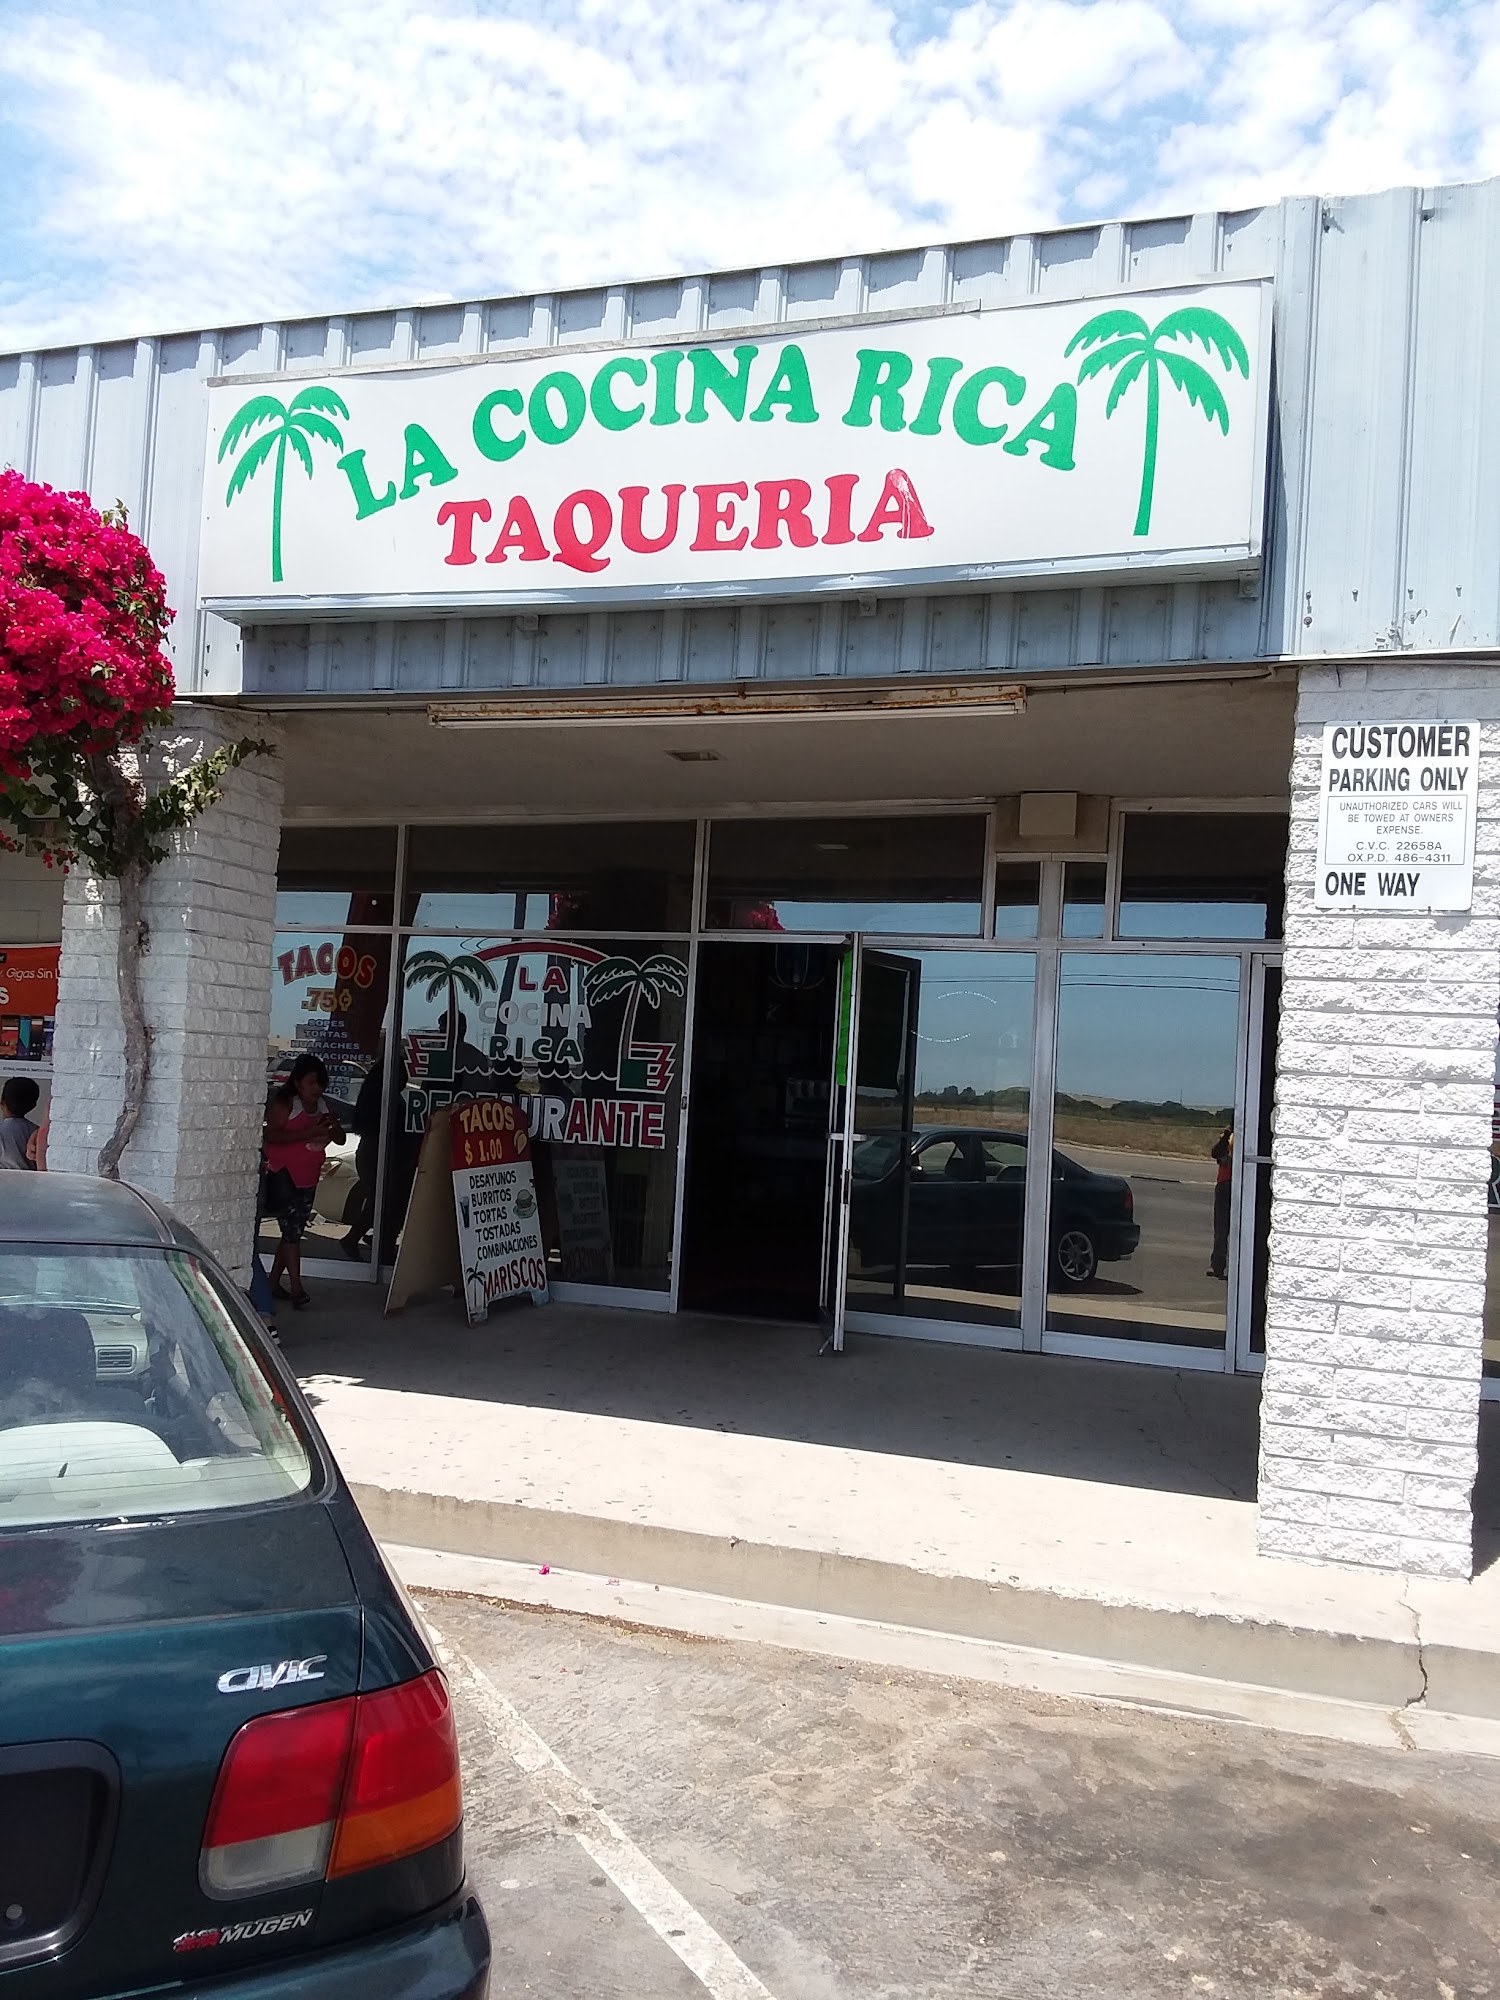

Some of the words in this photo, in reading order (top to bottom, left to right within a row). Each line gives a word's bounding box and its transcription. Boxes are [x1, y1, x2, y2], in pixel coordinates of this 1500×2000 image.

[337, 424, 457, 518] LA
[472, 344, 816, 460] COCINA
[842, 350, 1076, 471] RICA
[438, 468, 934, 572] TAQUERIA
[1332, 726, 1470, 759] CUSTOMER
[1328, 768, 1410, 792] PARKING
[1421, 767, 1469, 791] ONLY
[1340, 801, 1408, 811] UNAUTHORIZED
[1412, 801, 1437, 810] CARS
[1442, 801, 1462, 810] WILL
[1348, 814, 1359, 823] BE
[1364, 814, 1395, 823] TOWED
[1400, 814, 1410, 822] AT
[1414, 813, 1453, 822] OWNERS
[1376, 826, 1423, 834] EXPENSE.
[1348, 854, 1388, 862] OX.P.D.
[1394, 854, 1451, 862] 486-4311
[1356, 842, 1389, 850] C.V.C.
[1396, 842, 1442, 850] 22658A
[1325, 872, 1366, 896] ONE
[1378, 873, 1420, 896] WAY
[6, 967, 35, 981] Gigas
[37, 968, 53, 979] Sin
[277, 942, 377, 988] TACOS
[518, 966, 568, 993] LA
[308, 1019, 345, 1028] SOPES
[478, 1000, 592, 1029] COCINA
[292, 1041, 360, 1050] HUARACHES
[304, 1030, 348, 1039] TORTAS
[278, 1051, 372, 1061] COMINACIONES
[489, 1034, 584, 1064] RICA
[405, 1089, 666, 1149] RURANTE
[460, 1102, 515, 1134] TACOS
[465, 1140, 473, 1165] $
[478, 1138, 502, 1162] 1.00
[469, 1171, 517, 1190] DESAYUNOS
[471, 1188, 512, 1207] BURRITOS
[473, 1207, 508, 1224] TORTAS
[475, 1221, 521, 1243] TOSTADAS
[477, 1235, 538, 1261] COMBINACIONES
[483, 1256, 545, 1300] MARISCOS
[217, 1654, 327, 1693] CIVIC
[219, 1908, 314, 1944] MUGEN
